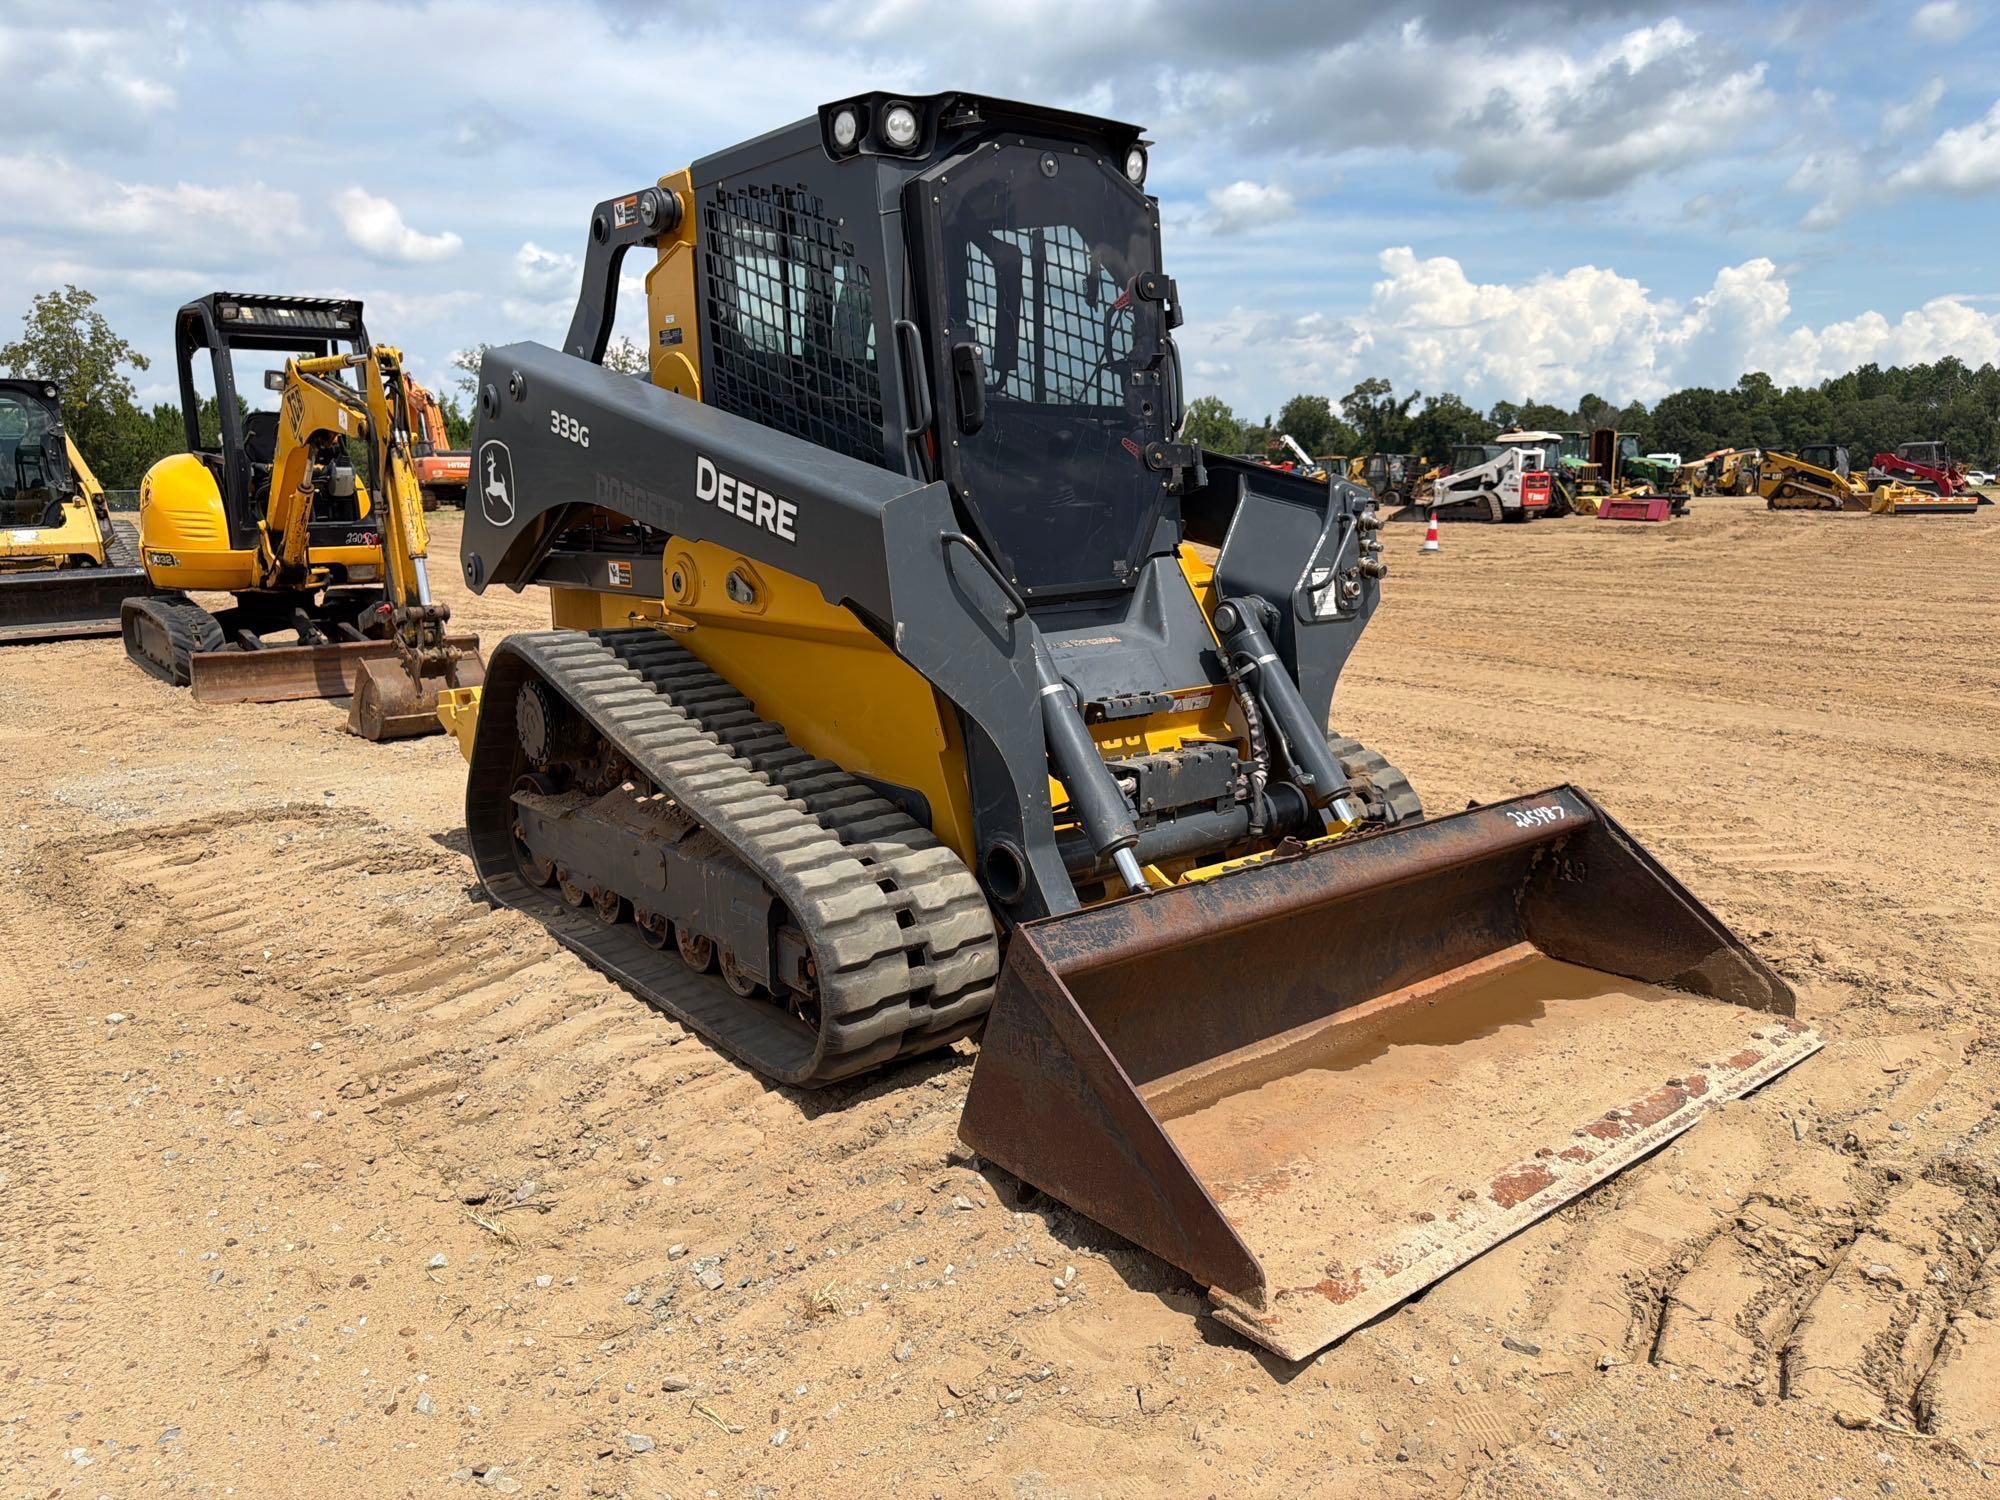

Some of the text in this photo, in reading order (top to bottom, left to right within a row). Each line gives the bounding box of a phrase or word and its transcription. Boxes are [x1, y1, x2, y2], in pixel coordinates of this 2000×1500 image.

[286, 388, 304, 434] JCB
[550, 410, 590, 448] 333G
[696, 455, 798, 542] DEERE
[1506, 806, 1565, 828] 225487
